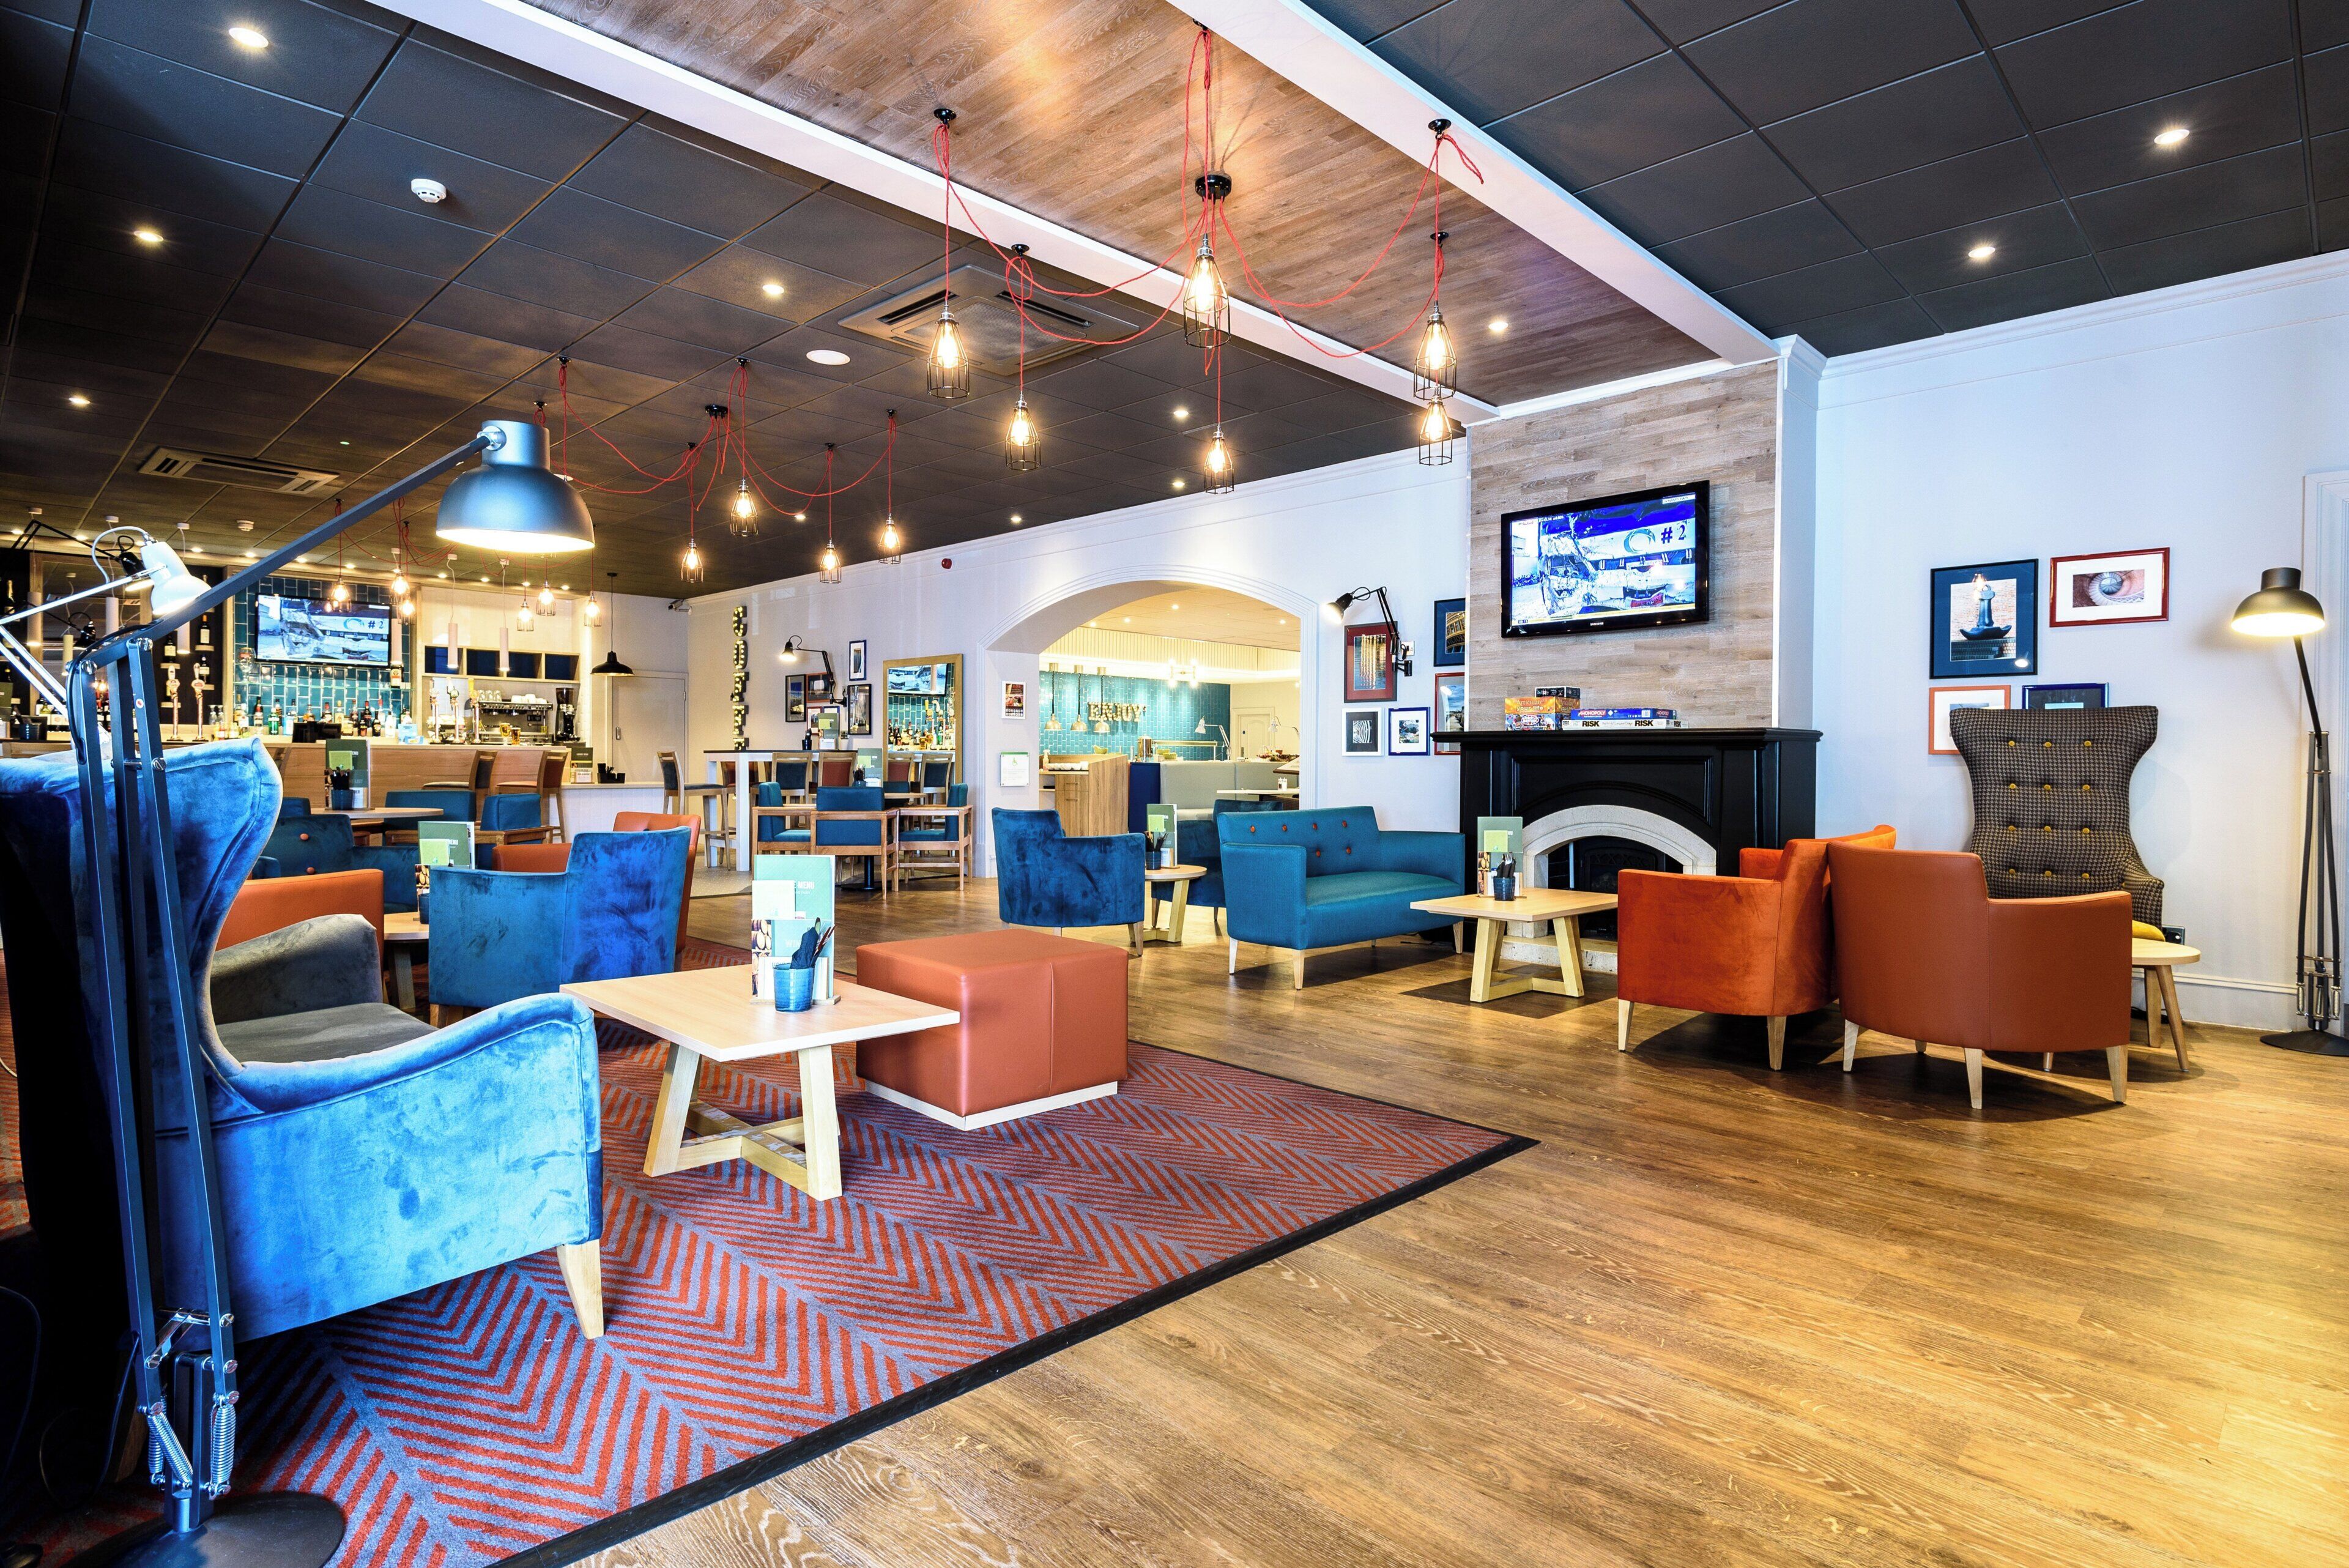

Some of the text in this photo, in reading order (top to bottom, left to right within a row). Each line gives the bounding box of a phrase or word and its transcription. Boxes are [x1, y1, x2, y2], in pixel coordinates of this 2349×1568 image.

[1678, 524, 1686, 540] 2
[1447, 634, 1465, 645] VICTOR
[1088, 702, 1145, 723] ENJOY
